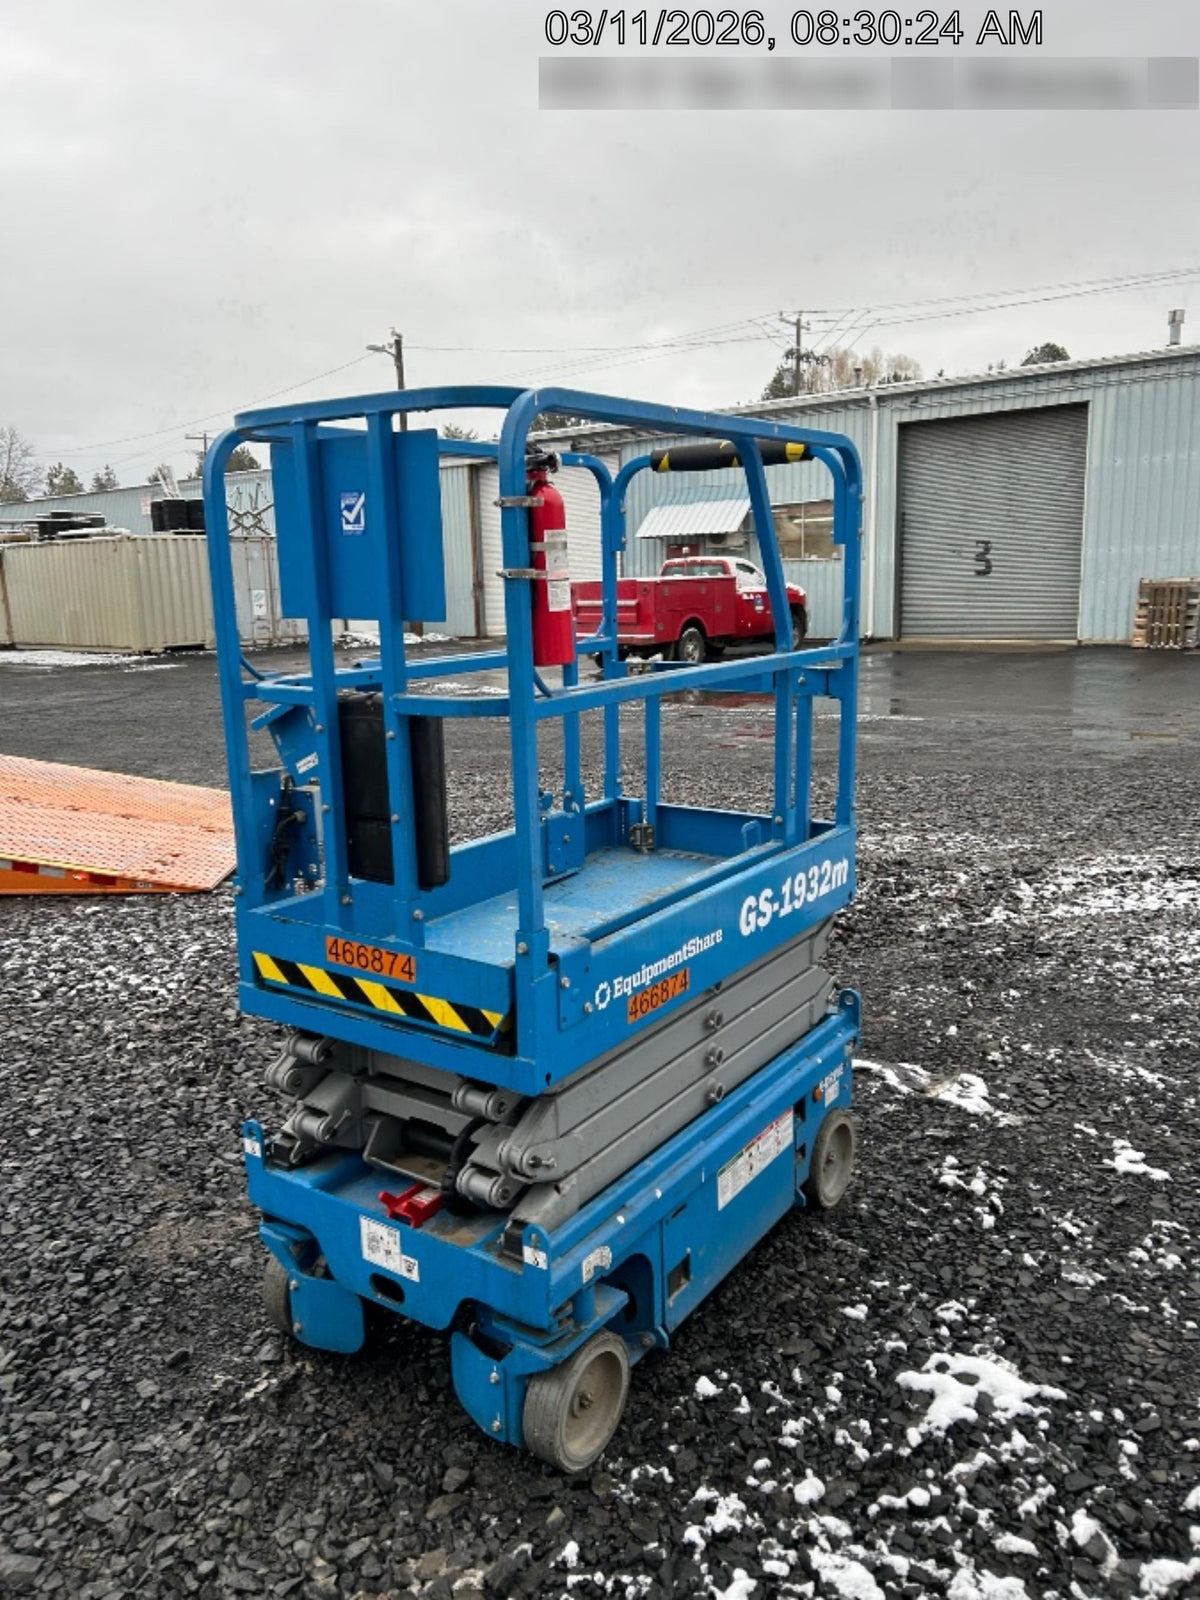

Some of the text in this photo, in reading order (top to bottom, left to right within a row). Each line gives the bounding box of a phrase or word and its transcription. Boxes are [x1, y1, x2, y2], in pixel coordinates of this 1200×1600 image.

[974, 540, 993, 576] 3
[739, 858, 849, 937] GS-1932m
[328, 938, 414, 980] 466874
[612, 928, 723, 1000] EquipmentShare
[628, 969, 689, 1019] 466874
